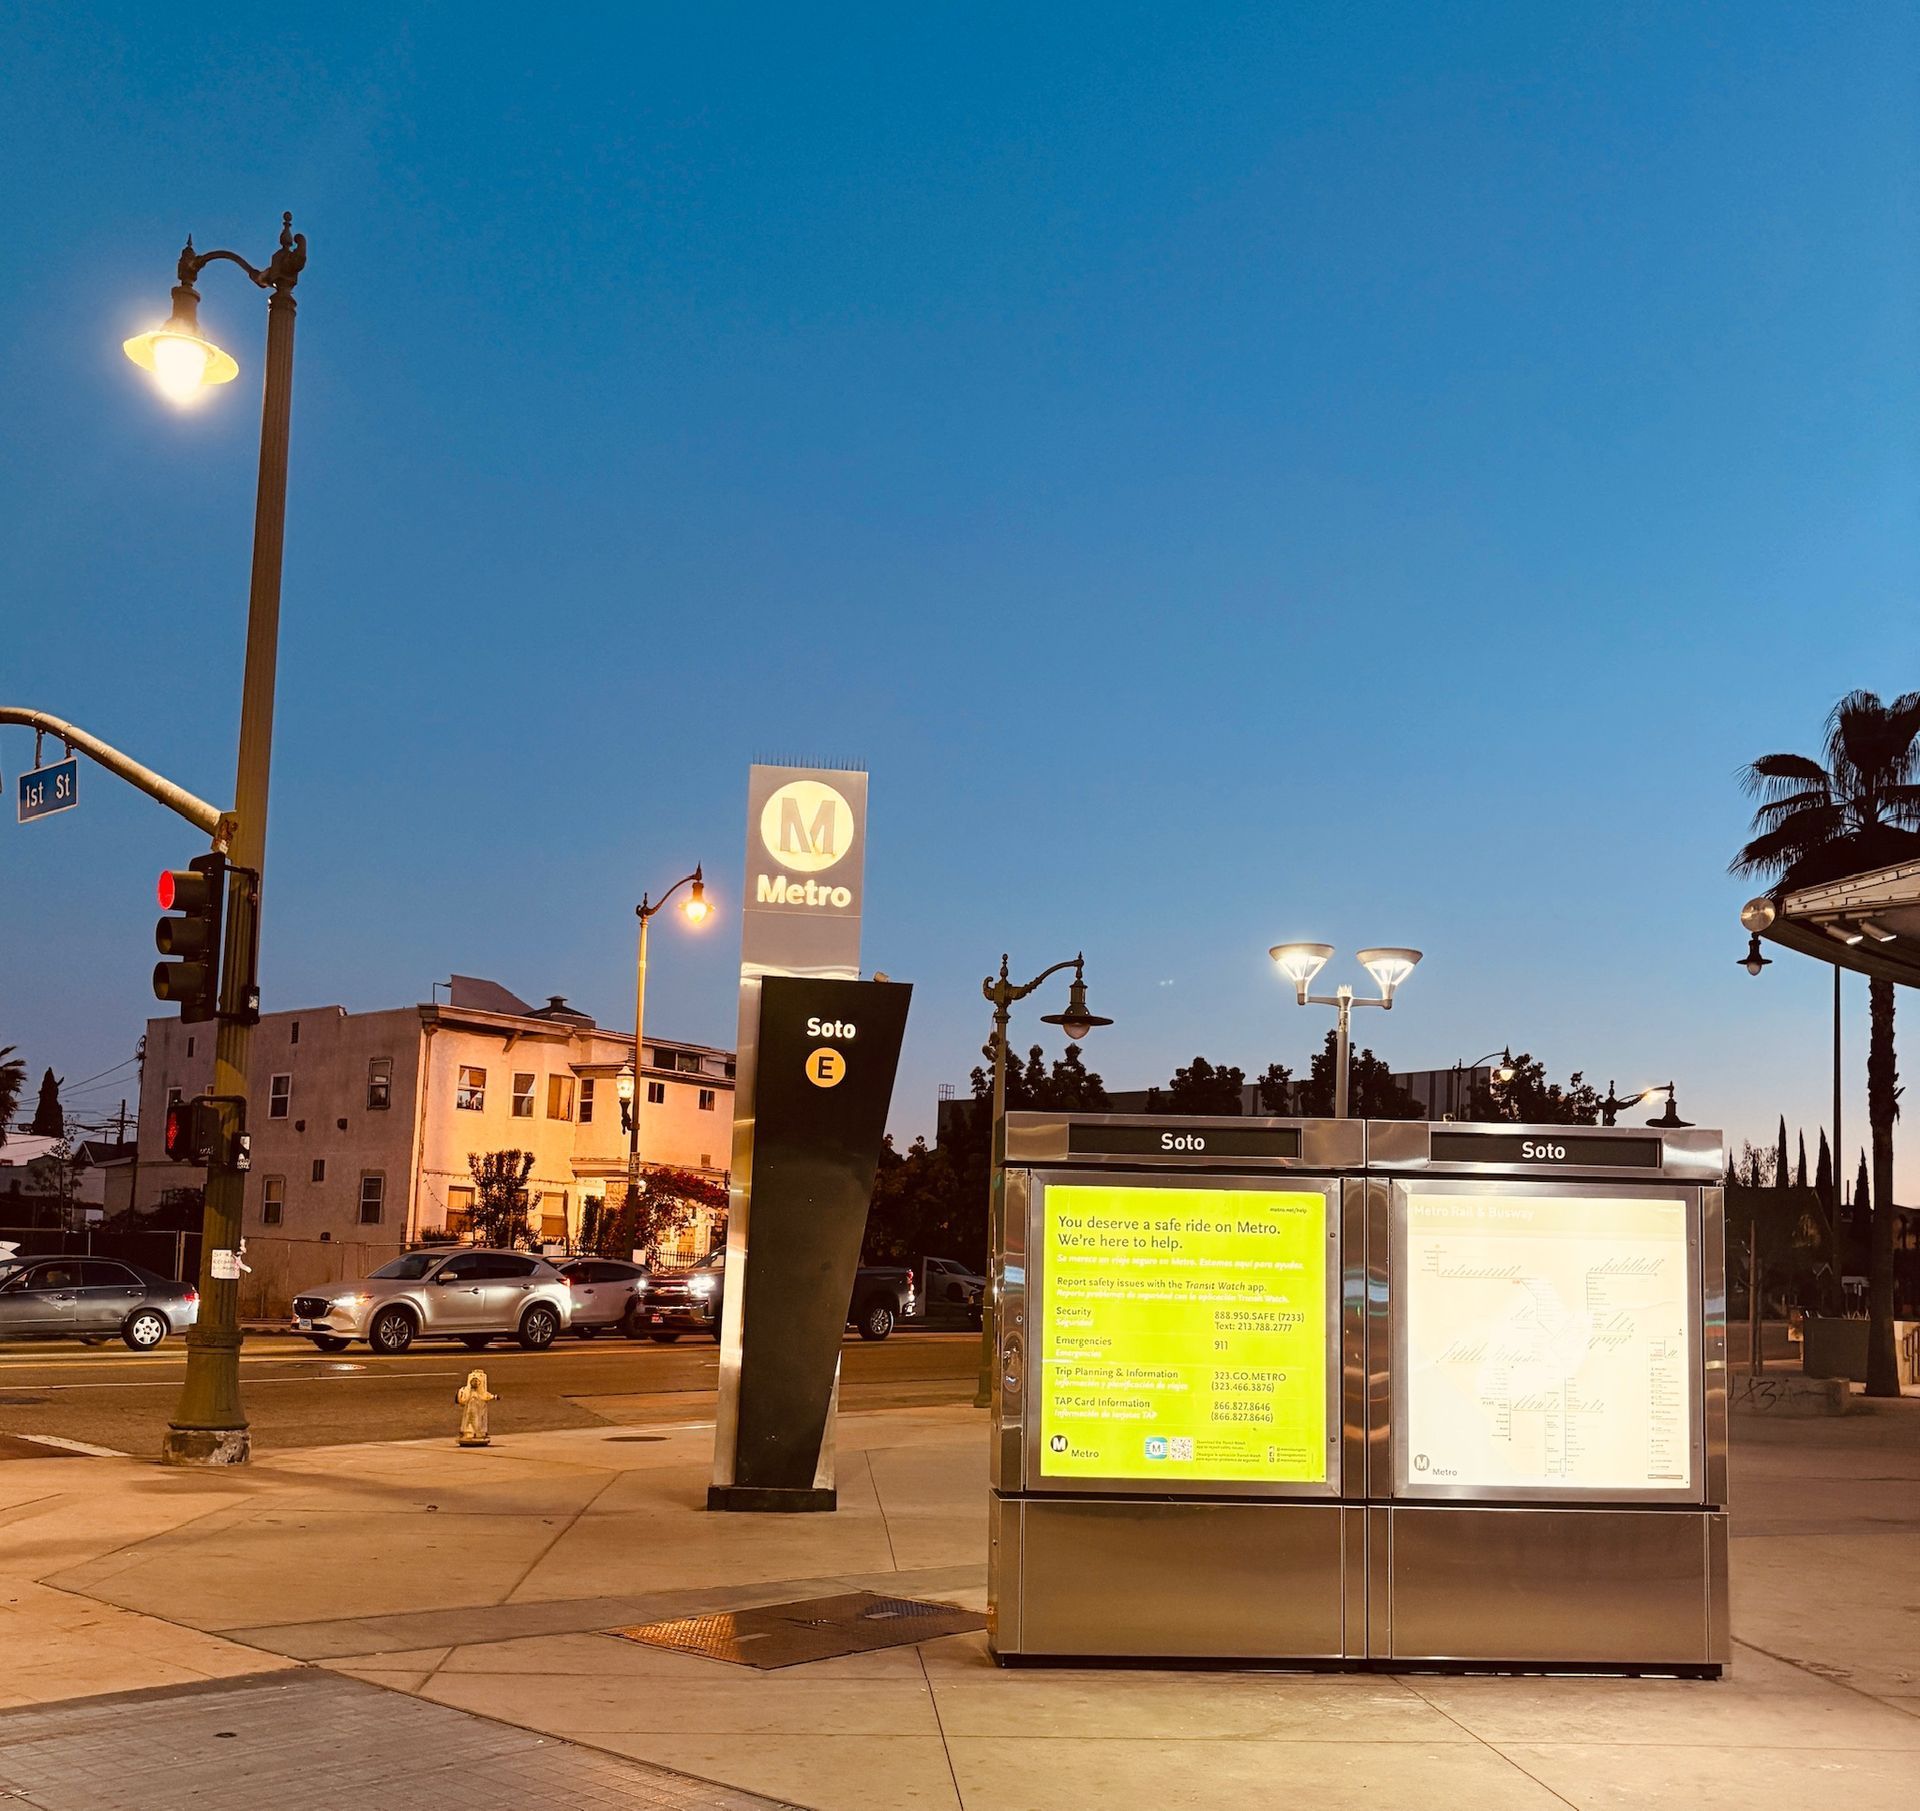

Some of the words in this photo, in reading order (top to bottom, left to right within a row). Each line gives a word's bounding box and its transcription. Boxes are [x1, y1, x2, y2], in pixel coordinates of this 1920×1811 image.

[26, 781, 44, 808] 1st
[56, 773, 70, 799] St
[780, 797, 836, 854] M
[757, 874, 852, 908] Metro
[806, 1017, 856, 1039] Soto
[818, 1056, 834, 1079] E
[1161, 1133, 1205, 1150] Soto
[1522, 1141, 1566, 1159] Soto
[1058, 1216, 1082, 1228] You
[1087, 1216, 1139, 1230] deserve
[1143, 1222, 1150, 1230] a
[1155, 1218, 1181, 1231] safe
[1185, 1219, 1211, 1232] ride
[1215, 1223, 1232, 1233] on
[1237, 1221, 1281, 1234] Metro.
[1100, 1234, 1129, 1247] here
[1133, 1236, 1147, 1248] to
[1151, 1236, 1183, 1252] help.
[1057, 1277, 1086, 1287] Report
[1089, 1277, 1114, 1289] safety
[1116, 1278, 1145, 1288] issues
[1147, 1279, 1166, 1288] with
[1168, 1280, 1183, 1289] the
[1185, 1281, 1215, 1290] Transit
[1218, 1281, 1245, 1291] Watch
[1248, 1284, 1267, 1294] app.
[1056, 1306, 1092, 1318] Security
[1214, 1311, 1275, 1321] 888.950.SAFE
[1278, 1312, 1305, 1323] (7233)
[1214, 1322, 1235, 1331] Text:
[1237, 1322, 1292, 1332] 213.788.2777
[1056, 1336, 1112, 1348] Emergencies
[1214, 1340, 1228, 1350] 911
[1055, 1367, 1072, 1378] Trip
[1075, 1367, 1114, 1379] Planning
[1116, 1368, 1124, 1377] &
[1126, 1369, 1179, 1379] Information
[1211, 1382, 1275, 1393] (323.466.3876)
[1054, 1397, 1072, 1405] TAP
[1074, 1397, 1096, 1406] Card
[1098, 1398, 1151, 1408] Information
[1214, 1401, 1271, 1411] 866.827.8646
[1211, 1412, 1274, 1423] (866.827.8646)
[1052, 1436, 1067, 1451] M
[1071, 1449, 1099, 1458] Metro
[1432, 1468, 1458, 1476] Metro
